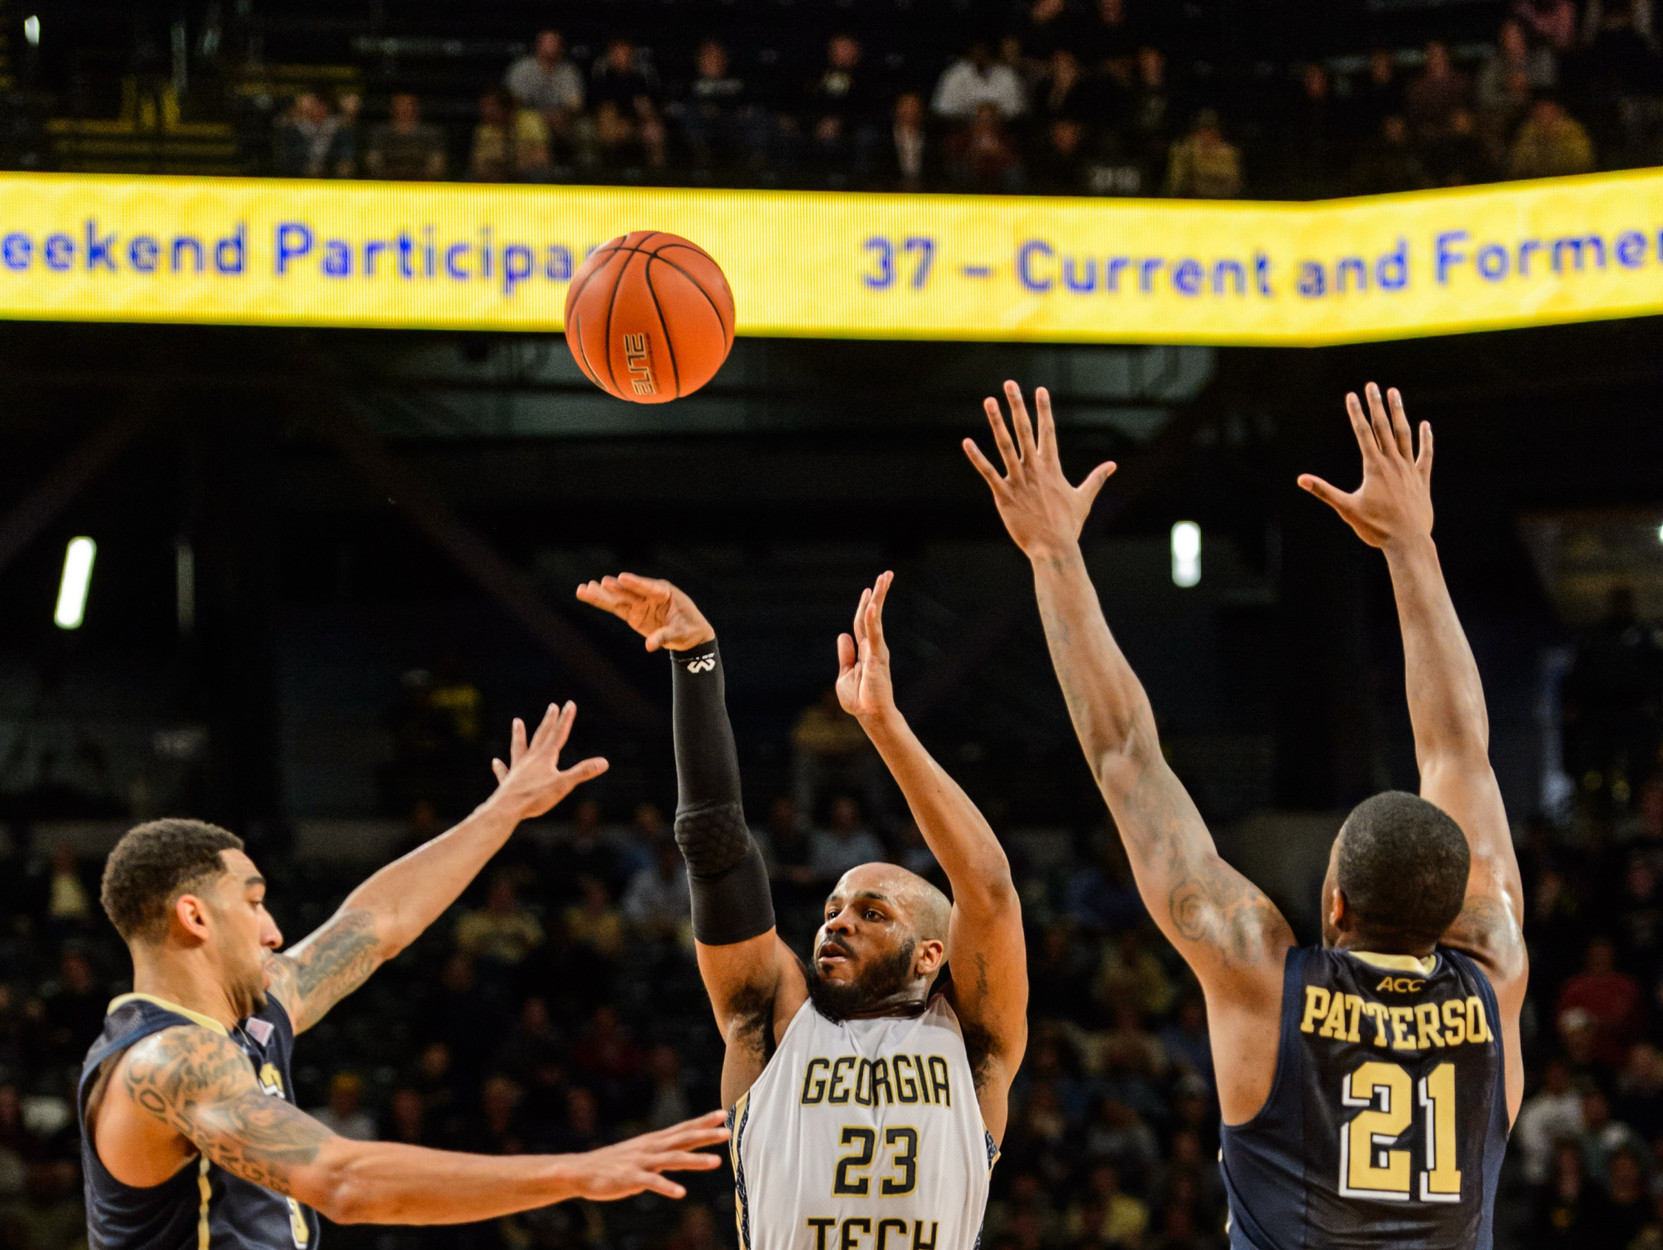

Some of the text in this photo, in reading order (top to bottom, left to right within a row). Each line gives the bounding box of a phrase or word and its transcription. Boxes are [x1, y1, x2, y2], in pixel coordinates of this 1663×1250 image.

[275, 222, 598, 297] Participa
[862, 236, 937, 291] 37
[1013, 239, 1272, 297] Current
[1298, 236, 1409, 297] and
[1434, 227, 1663, 286] Forme
[624, 334, 656, 395] ELITE
[1301, 985, 1494, 1050] PATTERSO
[1376, 976, 1426, 993] ACC
[801, 1054, 951, 1108] GEORGIA
[832, 1124, 920, 1198] 23
[1339, 1061, 1461, 1202] 21
